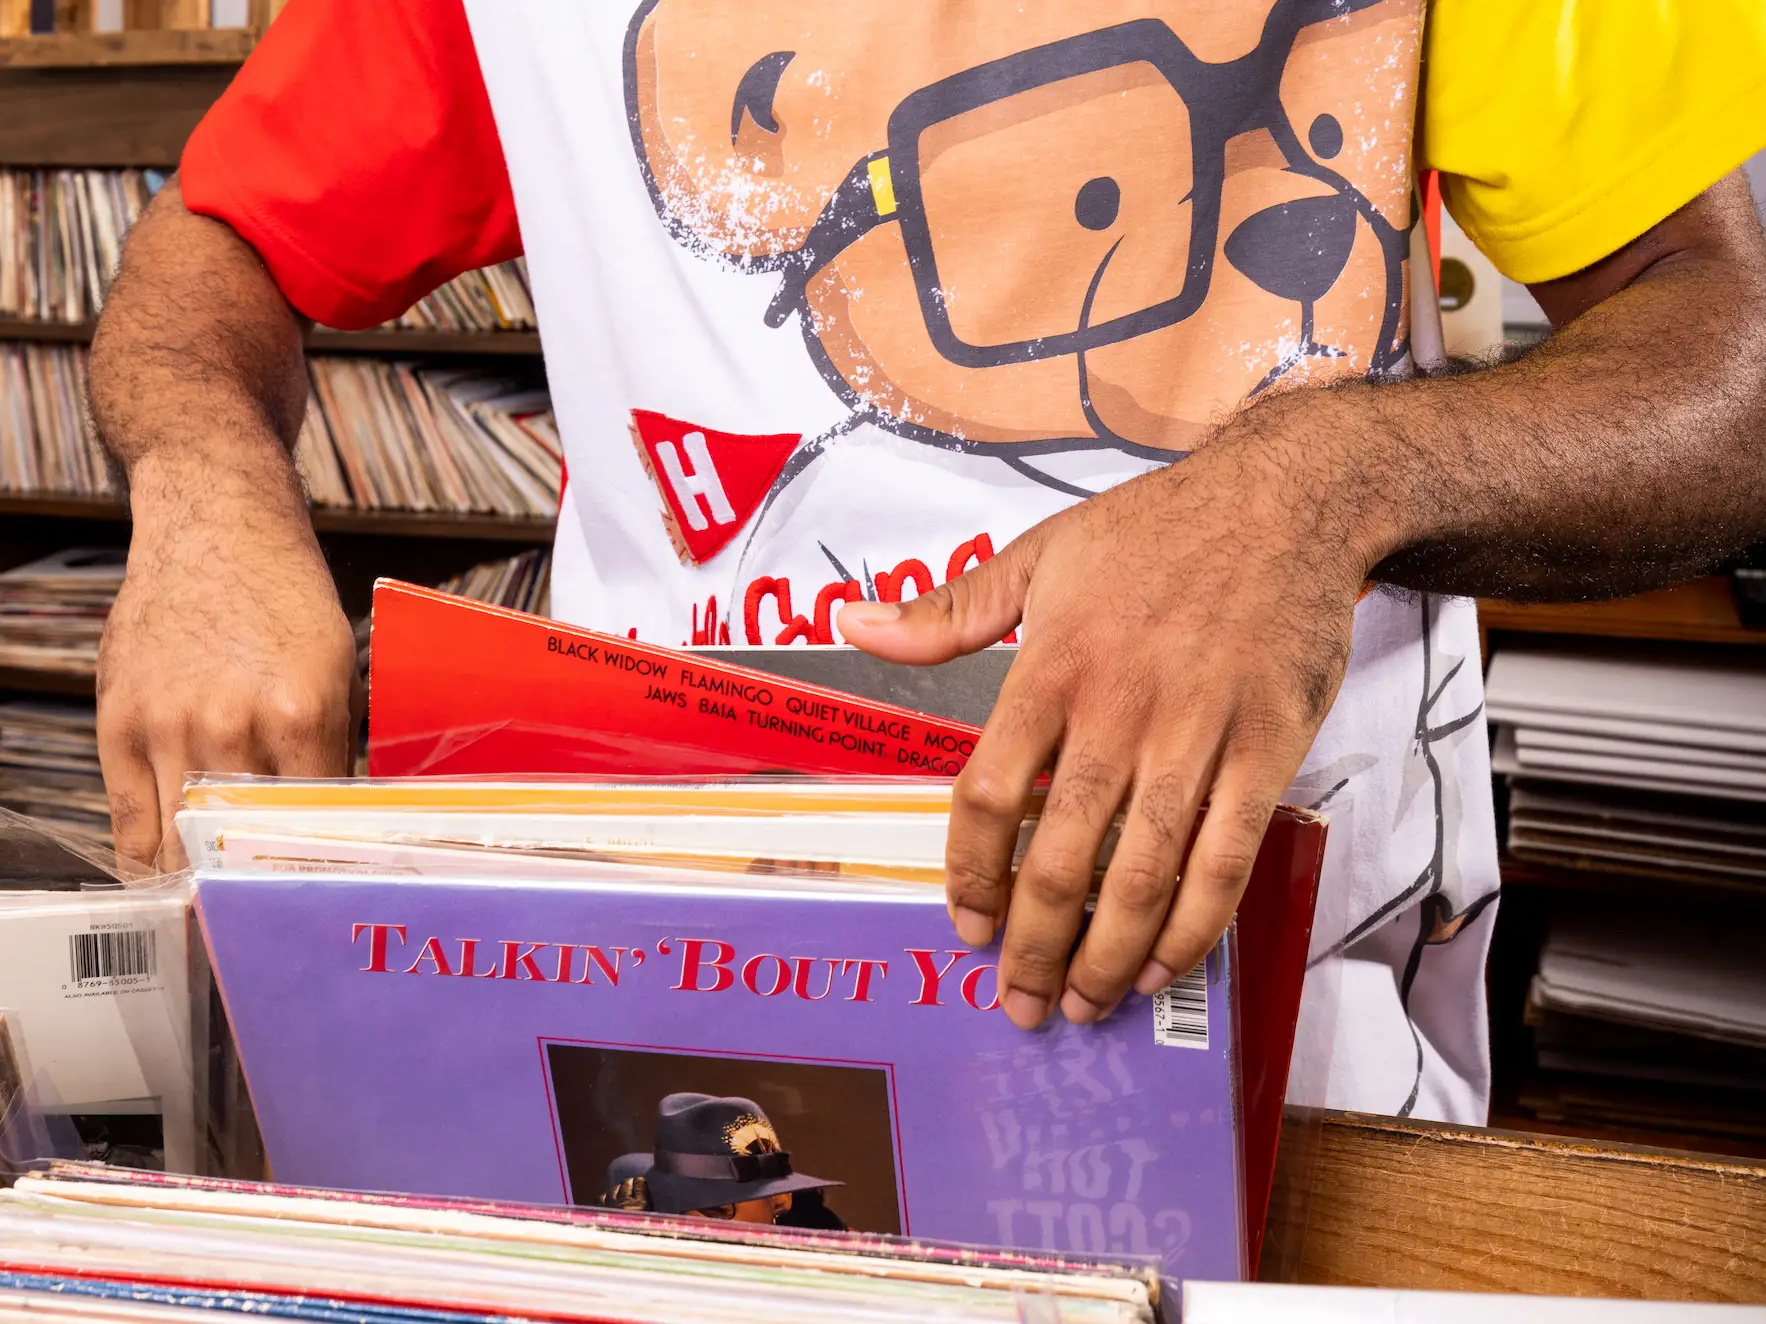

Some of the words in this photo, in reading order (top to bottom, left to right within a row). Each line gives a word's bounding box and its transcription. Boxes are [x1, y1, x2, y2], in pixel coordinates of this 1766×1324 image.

[656, 431, 736, 531] H
[547, 636, 598, 663] BLACK
[604, 650, 668, 679] WIDOW
[681, 669, 773, 706] FLAMINGO
[786, 697, 839, 723] QUIET
[844, 710, 911, 741] VILLAGE
[644, 685, 687, 708] JAWS
[699, 698, 737, 721] BAIA
[747, 709, 824, 743] TURNING
[828, 732, 886, 758] POINT
[897, 748, 963, 777] DRAGO
